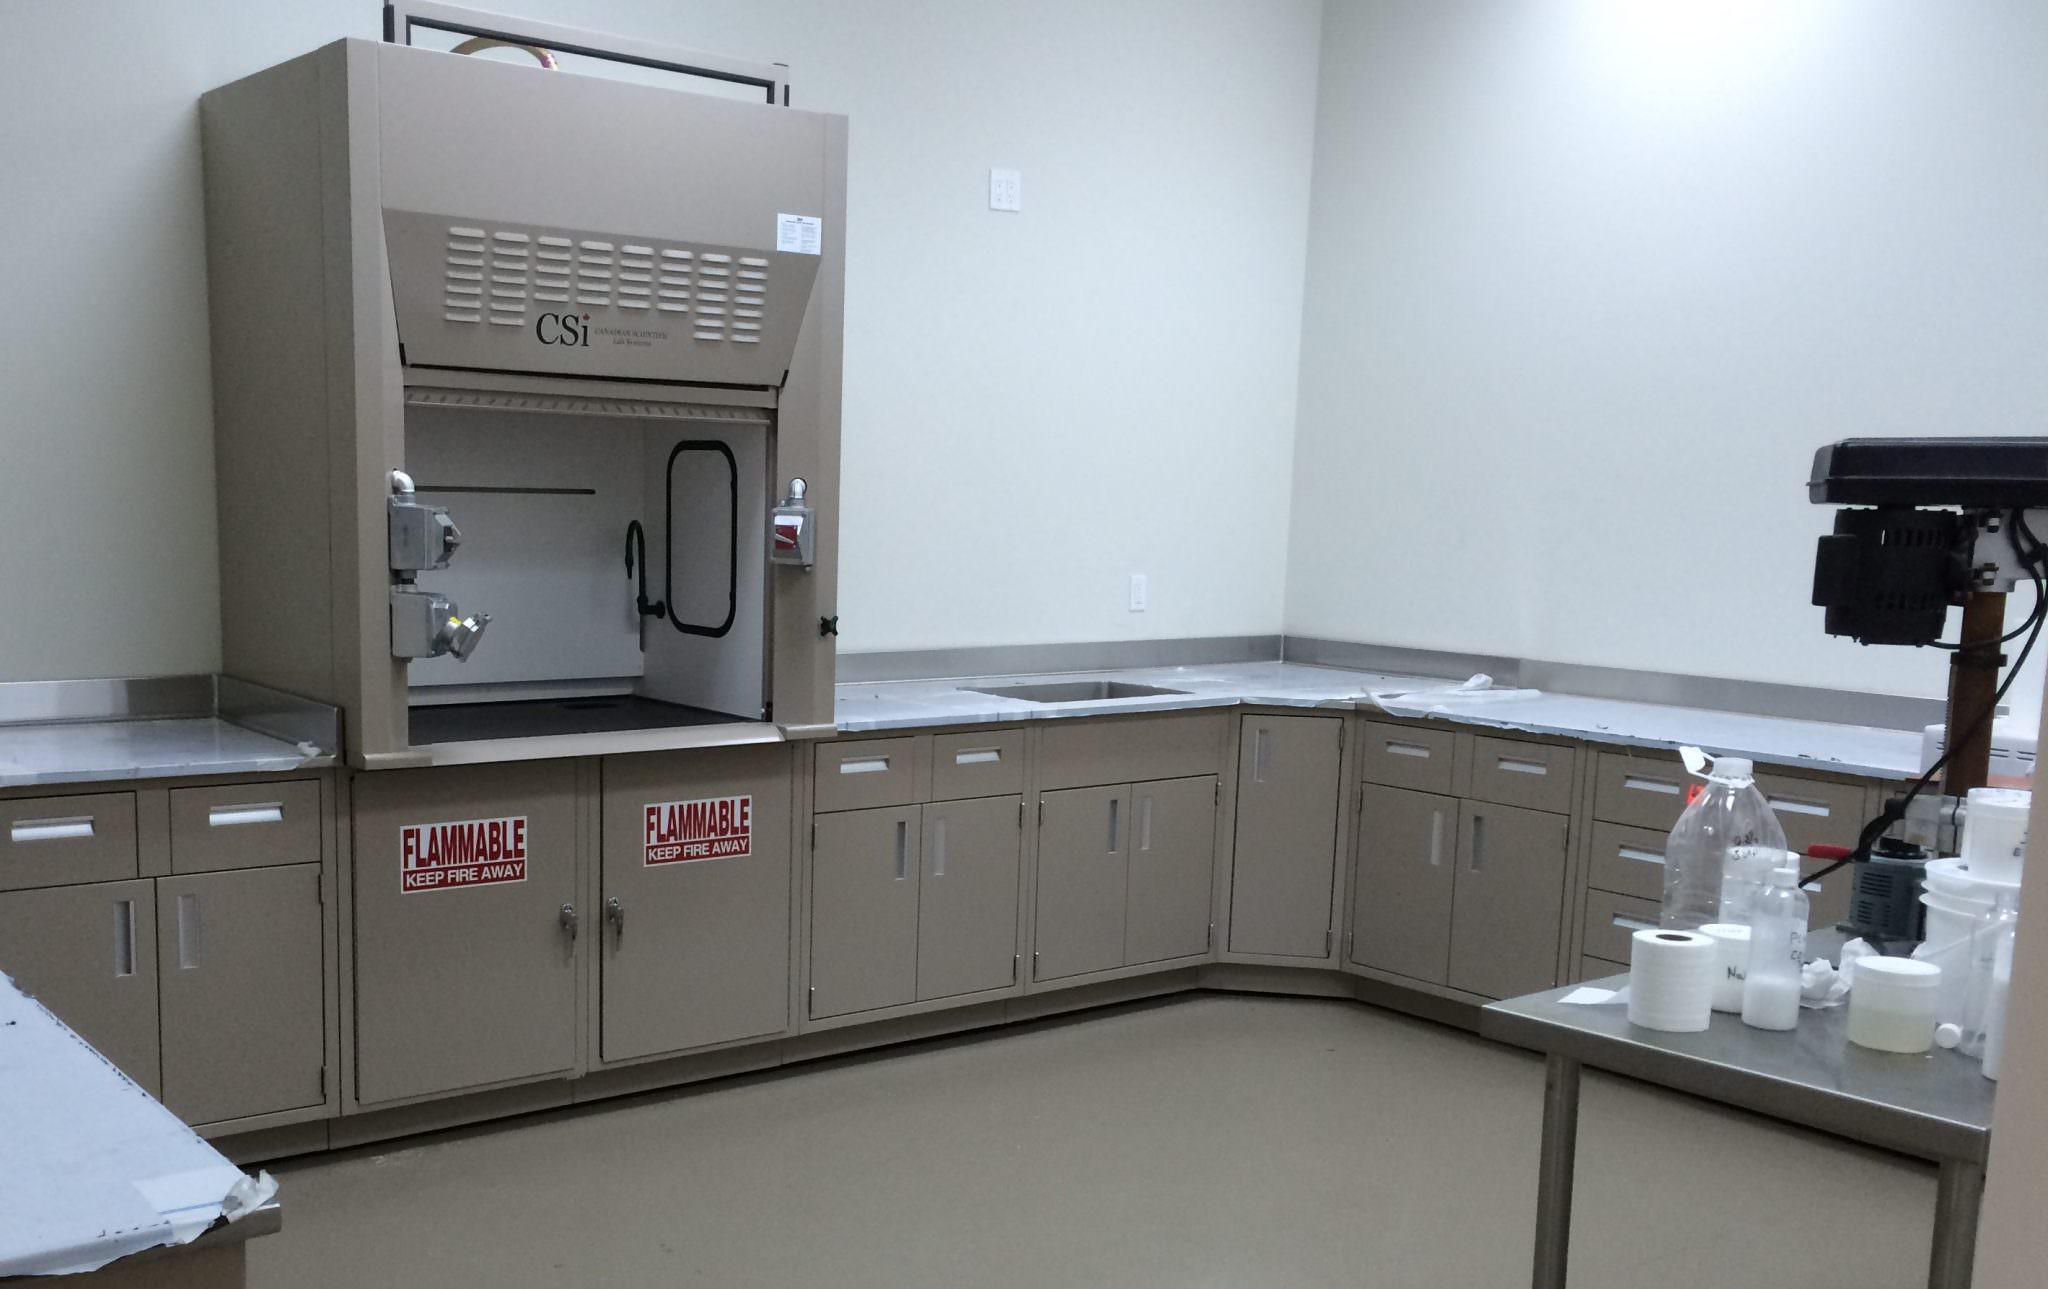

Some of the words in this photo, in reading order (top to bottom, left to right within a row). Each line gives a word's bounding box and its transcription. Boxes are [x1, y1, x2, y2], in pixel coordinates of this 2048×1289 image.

[536, 312, 591, 347] CSi
[646, 798, 751, 845] FLAMMABLE
[403, 819, 525, 869] FLAMMABLE
[648, 846, 682, 862] KEEP
[683, 842, 710, 857] FIRE
[712, 839, 748, 855] AWAY
[406, 871, 445, 888] KEEP
[447, 867, 478, 884] FIRE
[481, 863, 523, 880] AWAY
